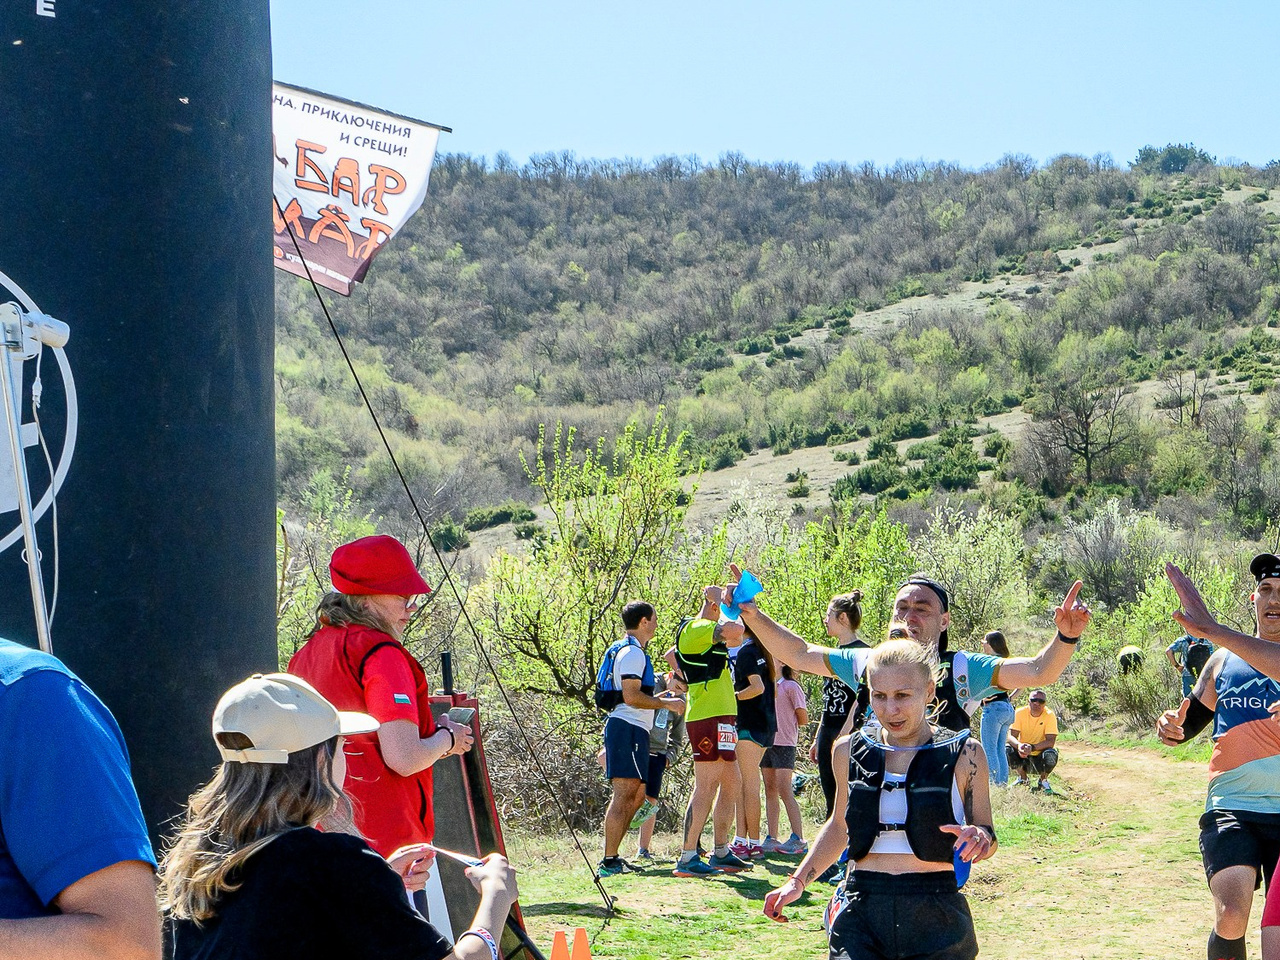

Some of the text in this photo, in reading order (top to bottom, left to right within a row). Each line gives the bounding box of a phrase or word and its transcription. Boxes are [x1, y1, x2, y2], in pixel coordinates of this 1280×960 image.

[273, 94, 411, 138] НА, ПРИКЛЮЧЕНИЯ
[339, 132, 408, 157] И СРЕЩИ!
